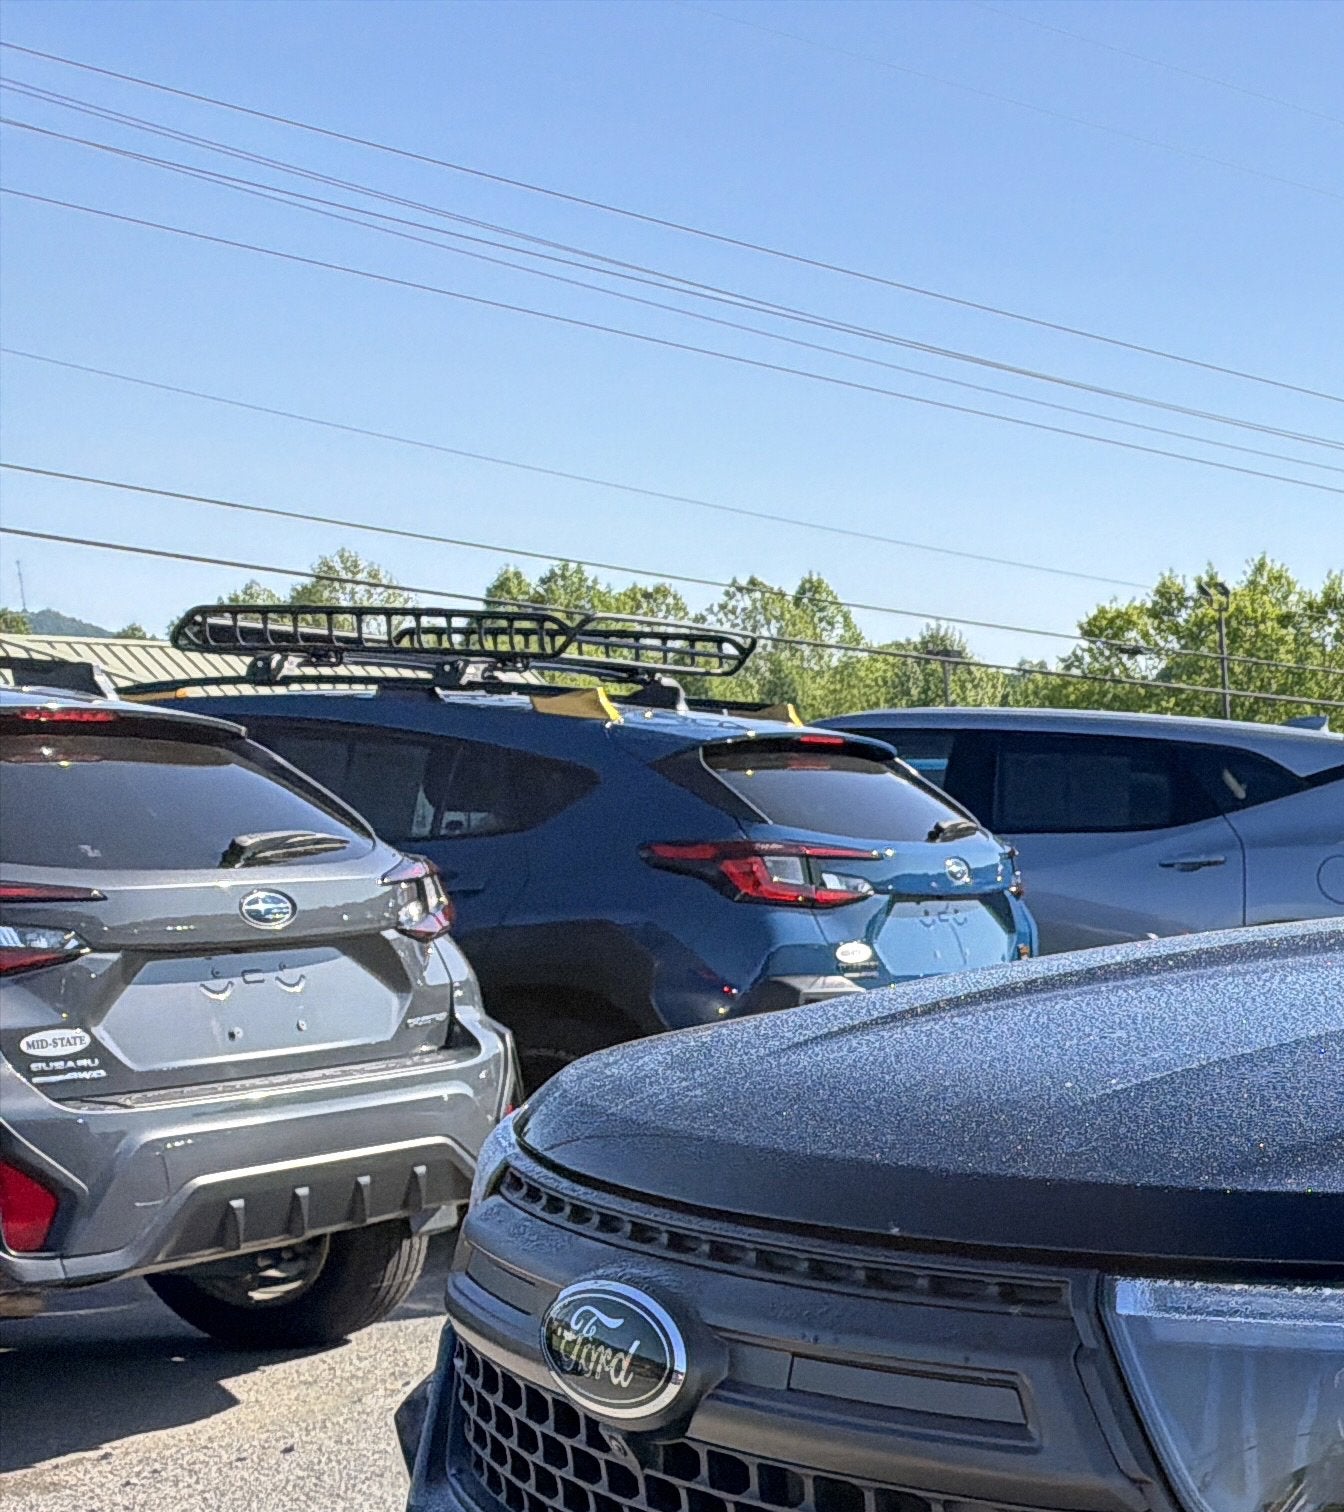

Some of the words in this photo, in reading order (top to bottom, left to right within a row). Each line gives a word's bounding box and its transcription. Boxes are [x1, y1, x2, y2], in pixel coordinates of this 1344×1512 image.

[26, 1036, 87, 1051] MID-STATE
[30, 1058, 99, 1071] SUBARU
[558, 1304, 641, 1388] Ford
